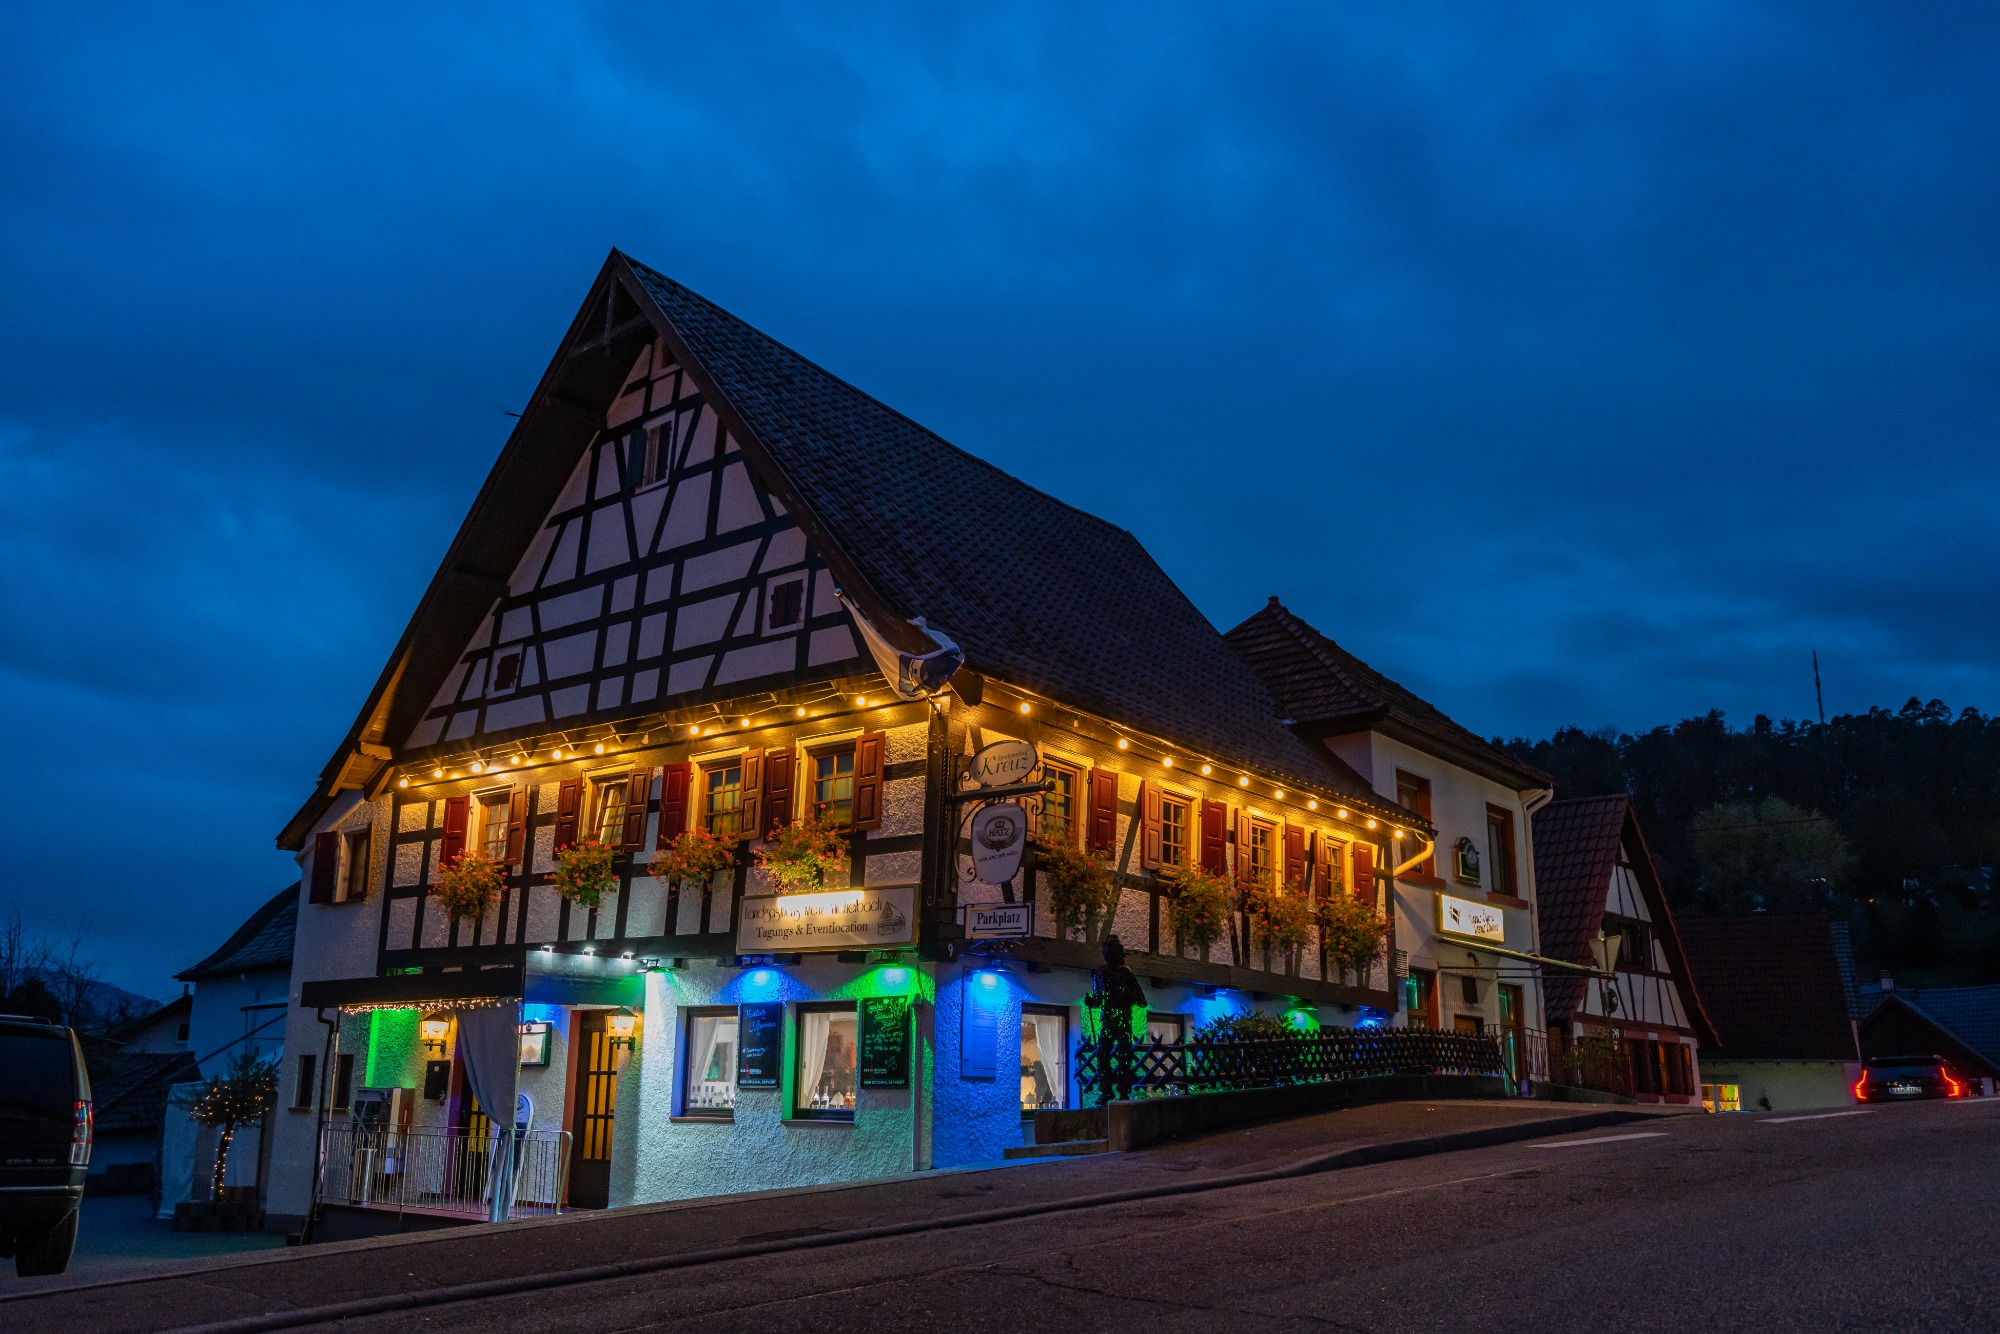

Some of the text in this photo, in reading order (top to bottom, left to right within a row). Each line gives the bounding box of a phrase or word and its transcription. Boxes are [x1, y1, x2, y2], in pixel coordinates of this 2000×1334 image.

[977, 755, 1029, 777] Kreuz
[989, 827, 1010, 837] HATZ
[977, 911, 1021, 927] Parkplatz
[755, 920, 868, 941] Tagungs & Eventlocation
